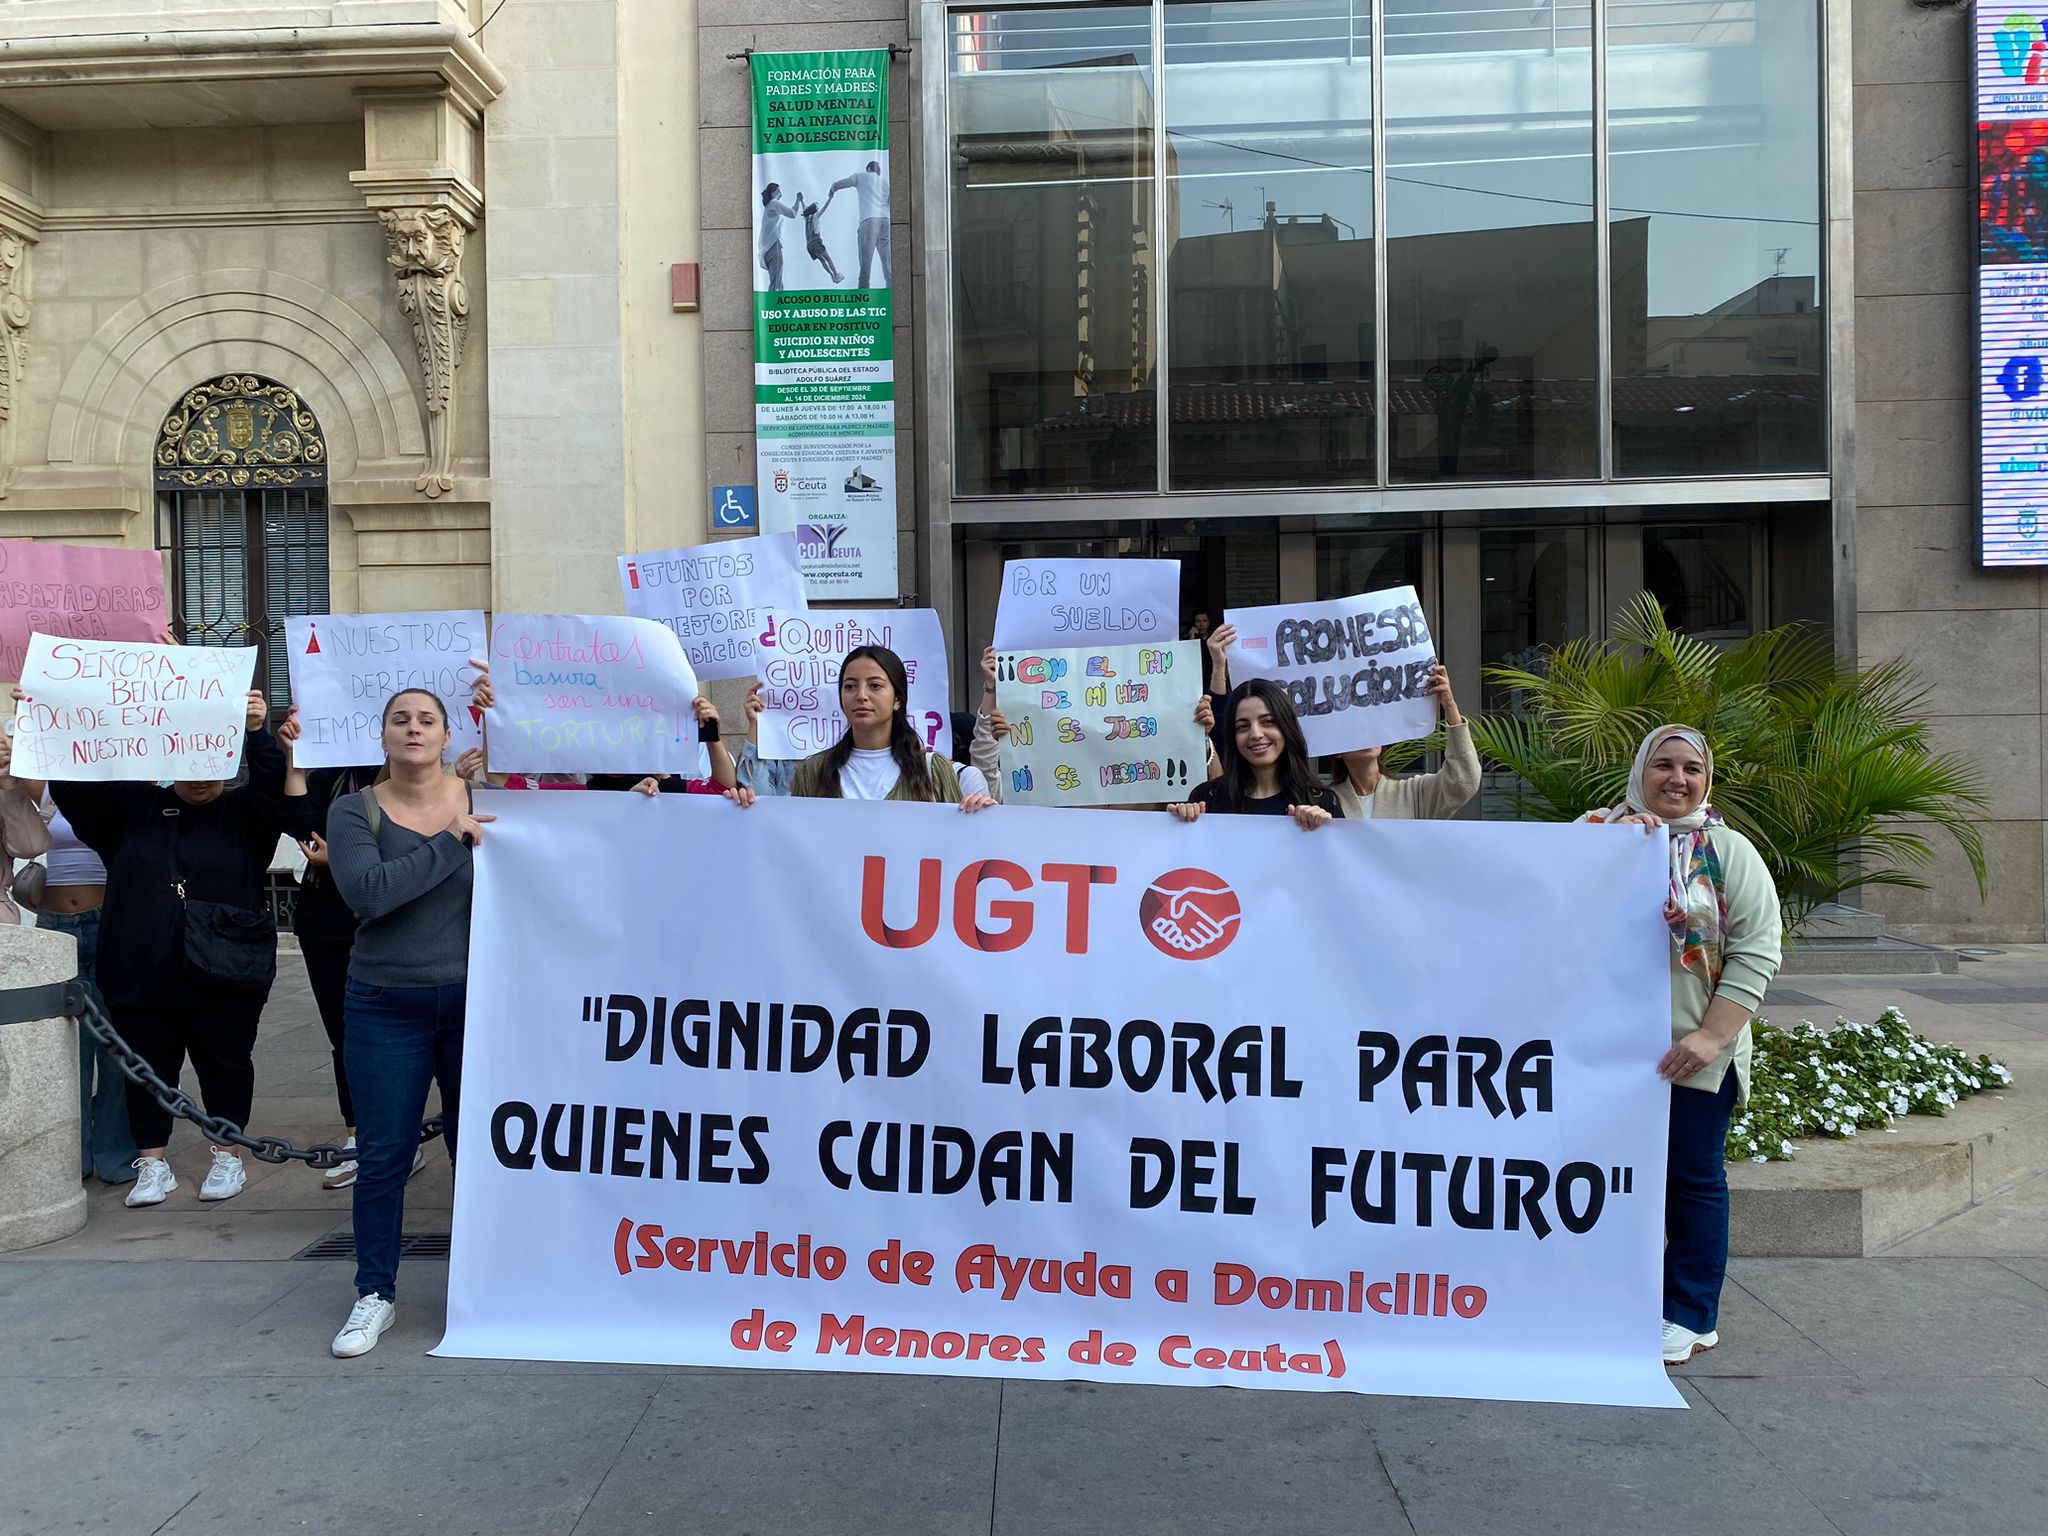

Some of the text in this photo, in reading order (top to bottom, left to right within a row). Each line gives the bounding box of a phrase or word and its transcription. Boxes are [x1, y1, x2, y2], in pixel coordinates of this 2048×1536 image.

[768, 68, 875, 81] FORMACIÓN PARA
[766, 82, 878, 96] PADRES Y MADRES:
[769, 99, 875, 112] SALUD MENTAL
[767, 115, 877, 128] EN LA INFANCIA
[764, 130, 881, 144] Y ADOLESCENCIA
[777, 296, 811, 304] ACOSO
[824, 294, 869, 302] BULLING
[761, 308, 886, 319] USO Y ABUSO DE LAS TIC
[768, 322, 880, 333] EDUCAR EN POSITIVO
[774, 334, 874, 346] SUICIDIO EN NIÑOS
[779, 348, 870, 359] Y ADOLESCENTES
[798, 481, 826, 489] Ceuta
[798, 543, 861, 558] COP CEUTA
[1013, 566, 1110, 596] POR UN
[0, 582, 161, 612] ABAJADORAS
[682, 584, 733, 608] POR
[25, 610, 107, 638] PARA
[652, 606, 774, 638] MEJORE
[1051, 604, 1157, 632] SUELDO
[494, 623, 645, 670] Contratos
[43, 644, 176, 680] SEÑORA
[514, 662, 604, 689] basura
[765, 656, 842, 689] CUID
[1086, 656, 1116, 678] EL
[1138, 649, 1173, 676] PAN
[352, 667, 474, 699] DERECHOS
[1041, 679, 1149, 709] DE MI HIJA
[544, 694, 664, 712] son una
[767, 688, 819, 710] LOS
[122, 705, 172, 726] ESTA
[1010, 715, 1157, 747] NI SE JUEGA
[73, 737, 148, 765] NUESTRO
[1012, 765, 1034, 793] NI
[1054, 764, 1081, 791] SE
[860, 854, 1117, 954] UGT
[582, 994, 1554, 1120] "DIGNIDAD LABORAL PARA
[490, 1100, 1633, 1242] QUIENES CUIDAN DEL FUTURO"
[614, 1216, 1488, 1320] (Servicio de Ayuda a Domicilio
[730, 1308, 1346, 1380] de Menores de Ceuta)
